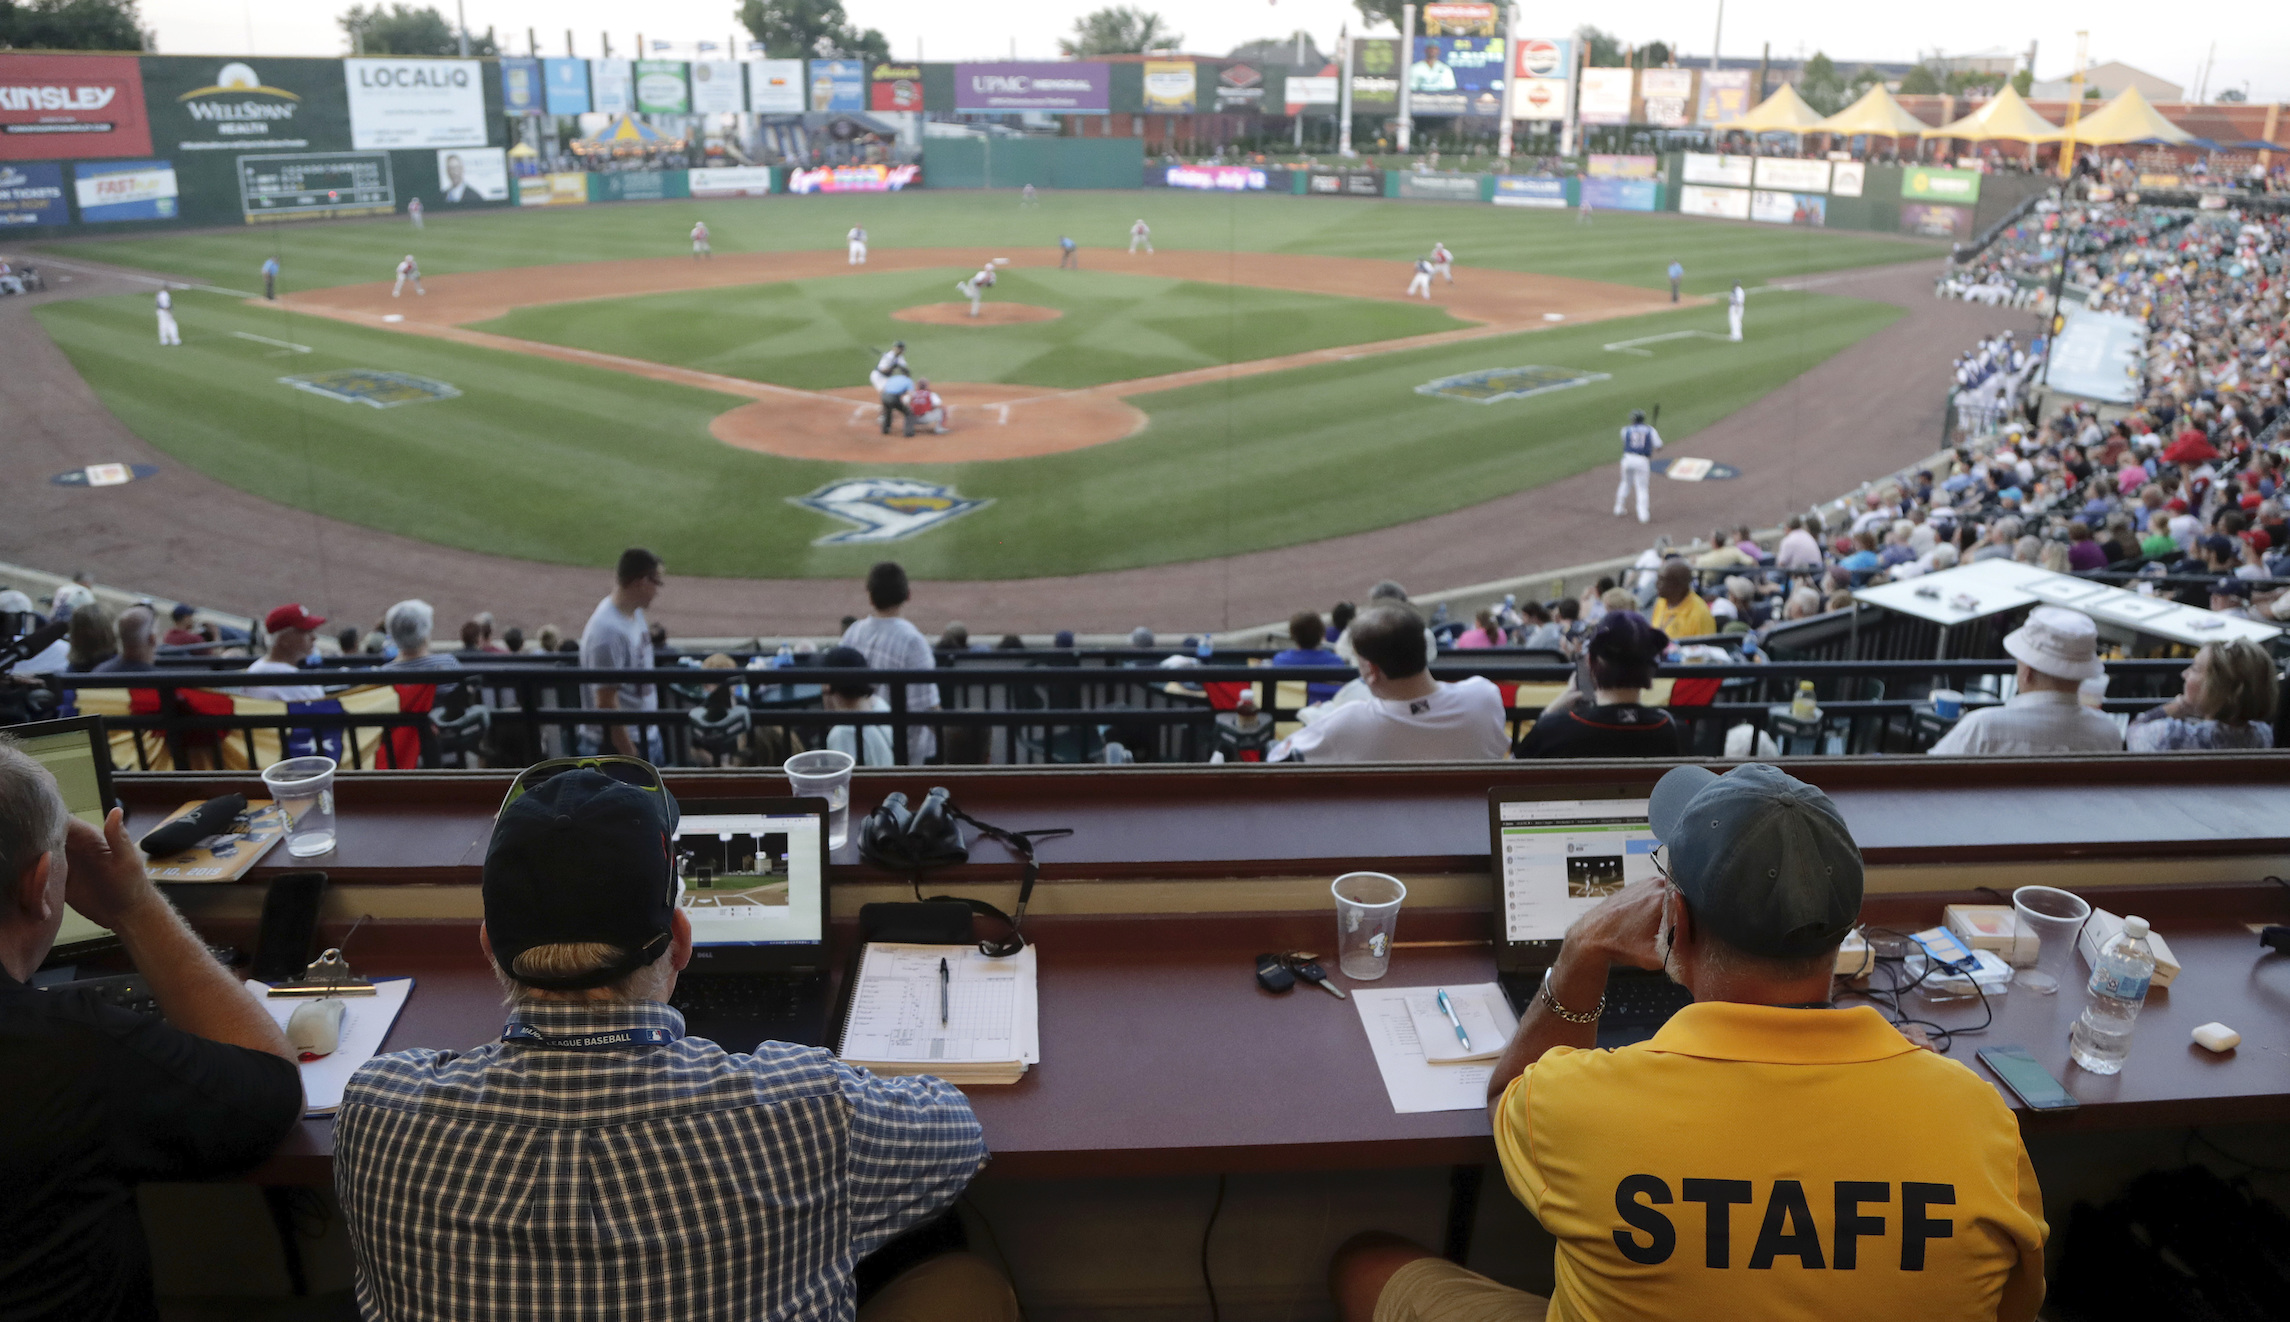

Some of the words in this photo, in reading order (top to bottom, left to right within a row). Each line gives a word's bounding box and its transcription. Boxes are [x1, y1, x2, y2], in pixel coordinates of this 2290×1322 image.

[360, 66, 469, 88] LOCALiQ
[972, 75, 1030, 94] UPMC
[1032, 78, 1093, 92] MEMORIAL
[0, 86, 116, 111] KINSLEY
[218, 122, 269, 135] HEALTH
[96, 178, 136, 195] FAST
[1166, 167, 1216, 189] Friday,
[1216, 167, 1247, 190] July
[11, 186, 62, 199] TICKETS
[186, 867, 224, 876] 2019
[584, 1033, 632, 1047] BASEBALL
[1612, 1173, 1956, 1271] STAFF
